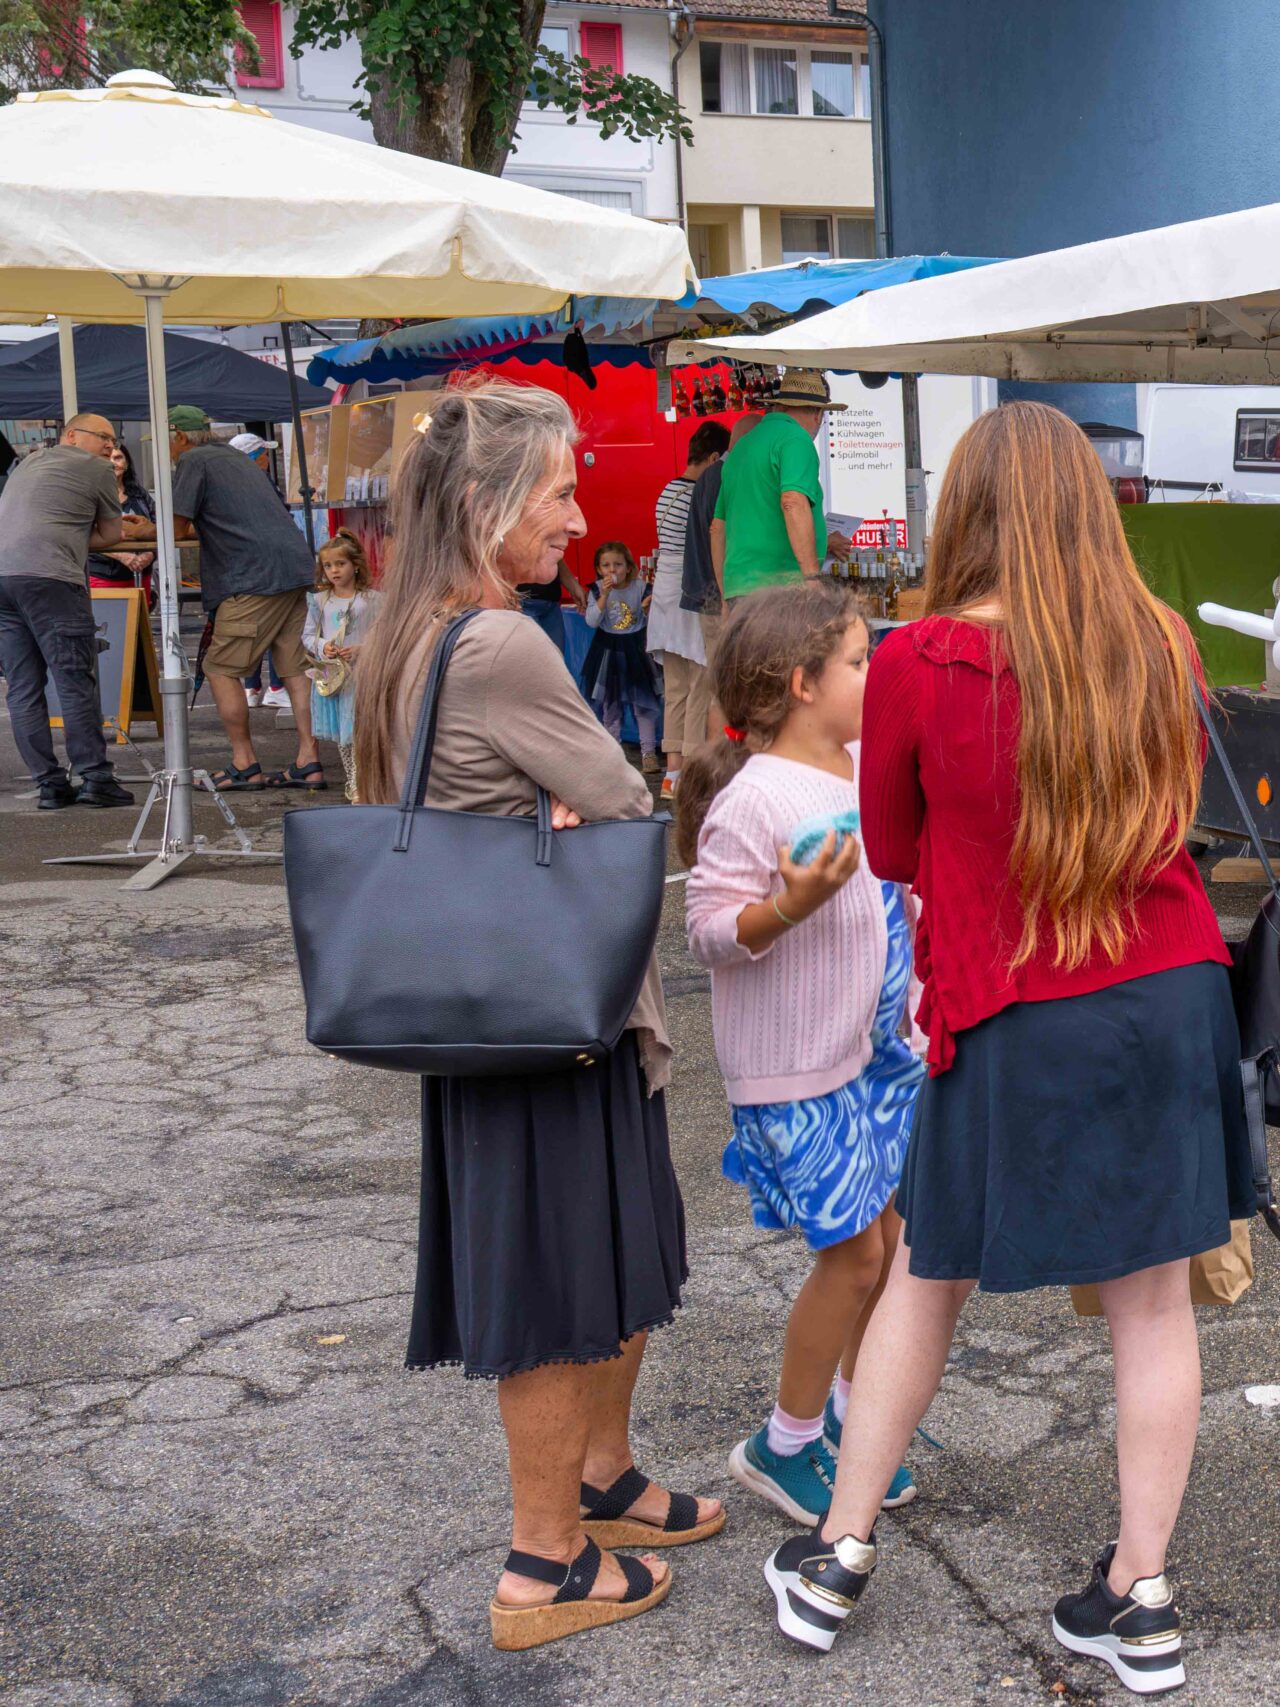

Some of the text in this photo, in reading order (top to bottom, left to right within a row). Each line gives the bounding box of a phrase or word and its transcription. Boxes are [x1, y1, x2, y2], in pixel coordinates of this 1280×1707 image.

[836, 420, 882, 428] Bierwagen
[837, 430, 884, 438] Kühlwagen
[838, 440, 903, 449] Toilettenwagen
[837, 450, 879, 460] Spülmobil
